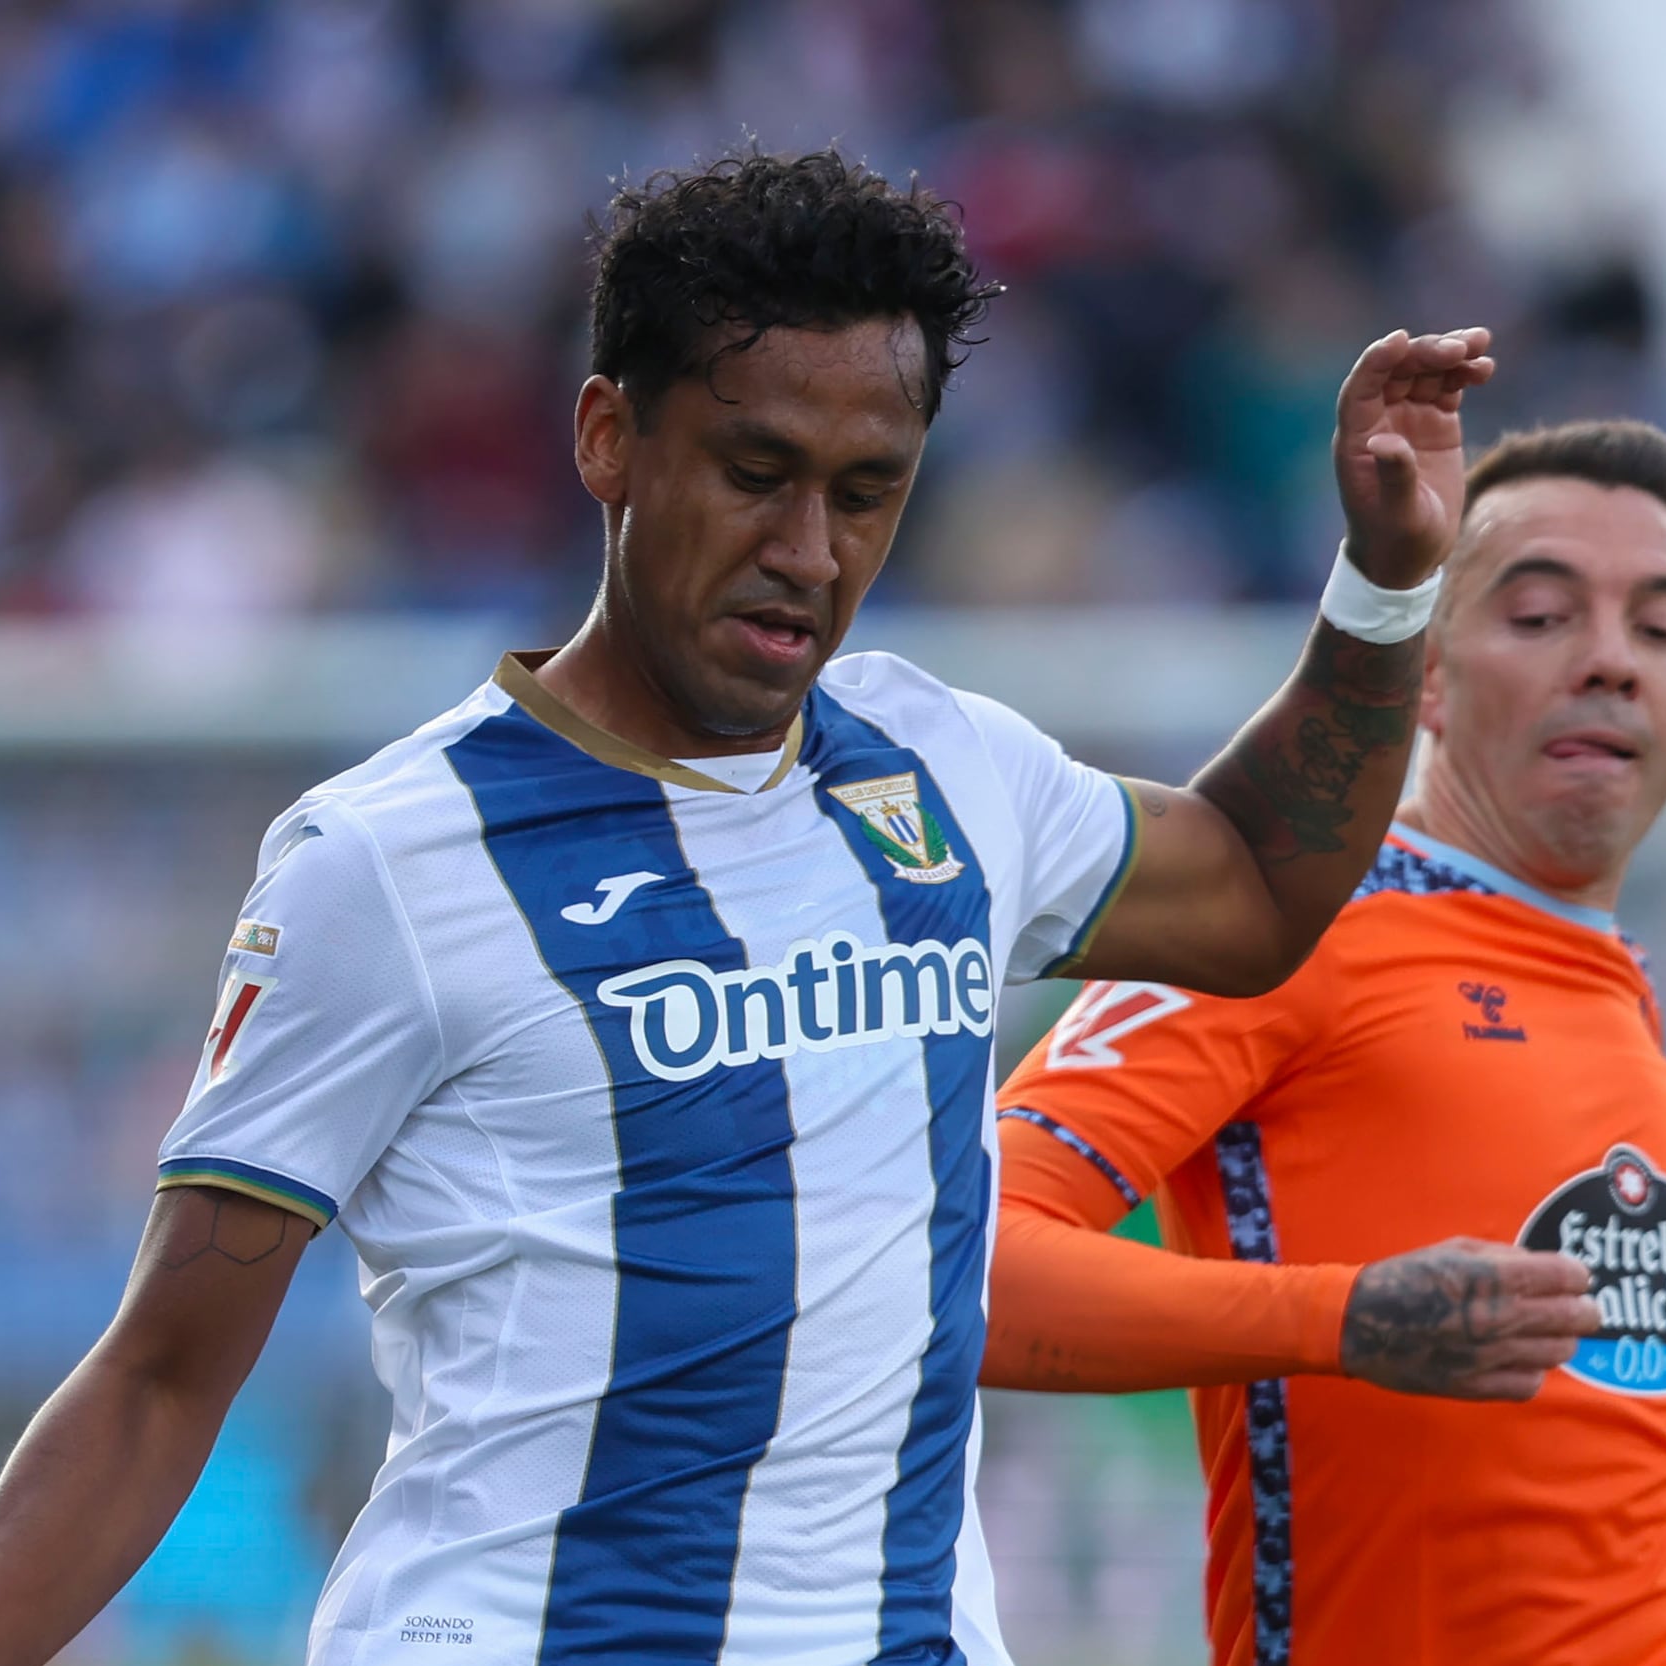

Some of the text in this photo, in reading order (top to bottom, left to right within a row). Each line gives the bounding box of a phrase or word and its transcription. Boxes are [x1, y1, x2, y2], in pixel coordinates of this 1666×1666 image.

[841, 779, 912, 800] CLUB DEPORTIVO
[607, 938, 991, 1070] Ontime
[404, 1615, 474, 1629] SOÑANDO
[400, 1630, 473, 1645] DESDE 1928
